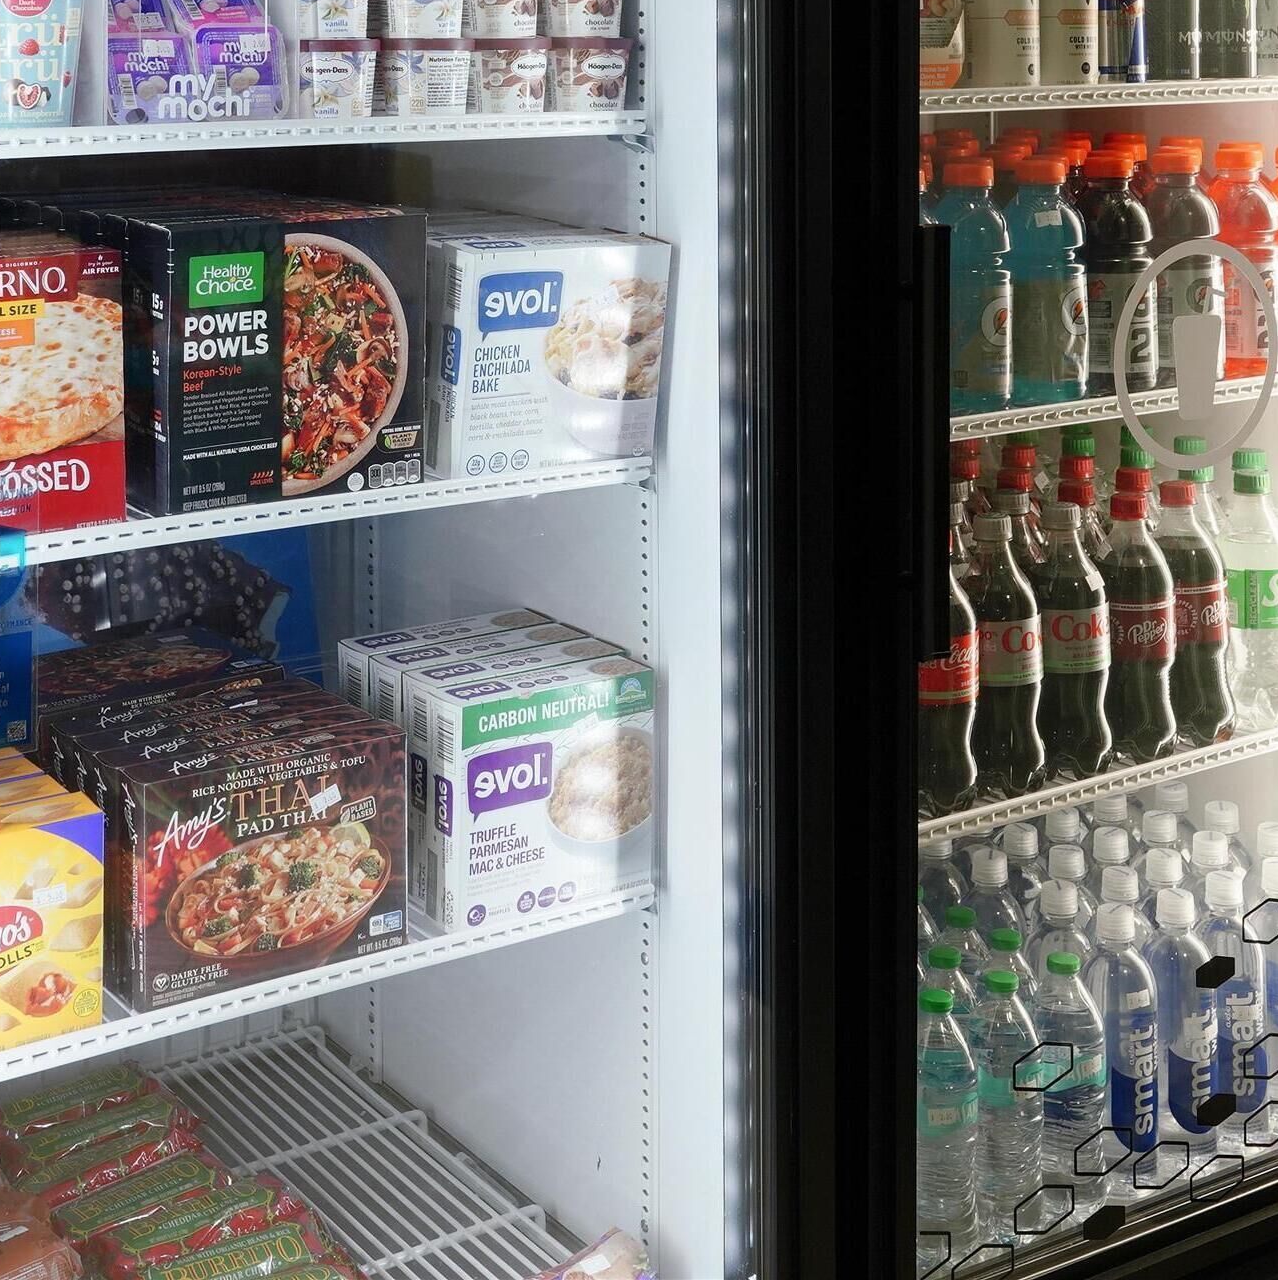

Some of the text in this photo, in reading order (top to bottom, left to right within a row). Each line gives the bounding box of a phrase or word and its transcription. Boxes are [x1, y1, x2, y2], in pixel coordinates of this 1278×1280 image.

[125, 59, 169, 73] mochi
[220, 52, 263, 63] mochi
[169, 74, 216, 101] my
[158, 87, 251, 121] mochi
[315, 107, 338, 115] vanilla
[96, 266, 119, 274] FRYER
[203, 263, 252, 279] Healthy
[195, 278, 254, 295] Choice
[9, 304, 37, 316] SIZE
[185, 310, 268, 337] POWER
[183, 334, 269, 363] BOWLS
[475, 345, 520, 362] CHICKEN
[184, 364, 242, 380] Korean-Style
[473, 360, 531, 378] ENCHILADA
[184, 380, 204, 392] Beef
[472, 378, 499, 394] BAKE
[479, 705, 538, 733] CARBON
[541, 693, 609, 719] NEUTRAL!
[140, 736, 191, 760] Amy's
[169, 752, 221, 775] Amy's
[227, 754, 331, 781] MADE WITH ORGANIC
[192, 756, 366, 798] RICE NOODLES, VEGETABLES & TOFU
[474, 753, 547, 798] evol.
[350, 808, 374, 820] BASED
[351, 800, 373, 814] PLANT
[153, 775, 330, 868] Amy's THAI
[236, 819, 274, 838] PAD
[470, 824, 516, 845] TRUFFLE
[470, 836, 528, 860] PARMESAN
[469, 847, 545, 876] MAC & CHEESE
[171, 963, 221, 981] DAIRY FREE
[171, 969, 229, 989] GLUTEN FREE
[1130, 1024, 1154, 1136] smart
[162, 1211, 202, 1229] CHEDDAR
[160, 1235, 303, 1280] BURRITO
